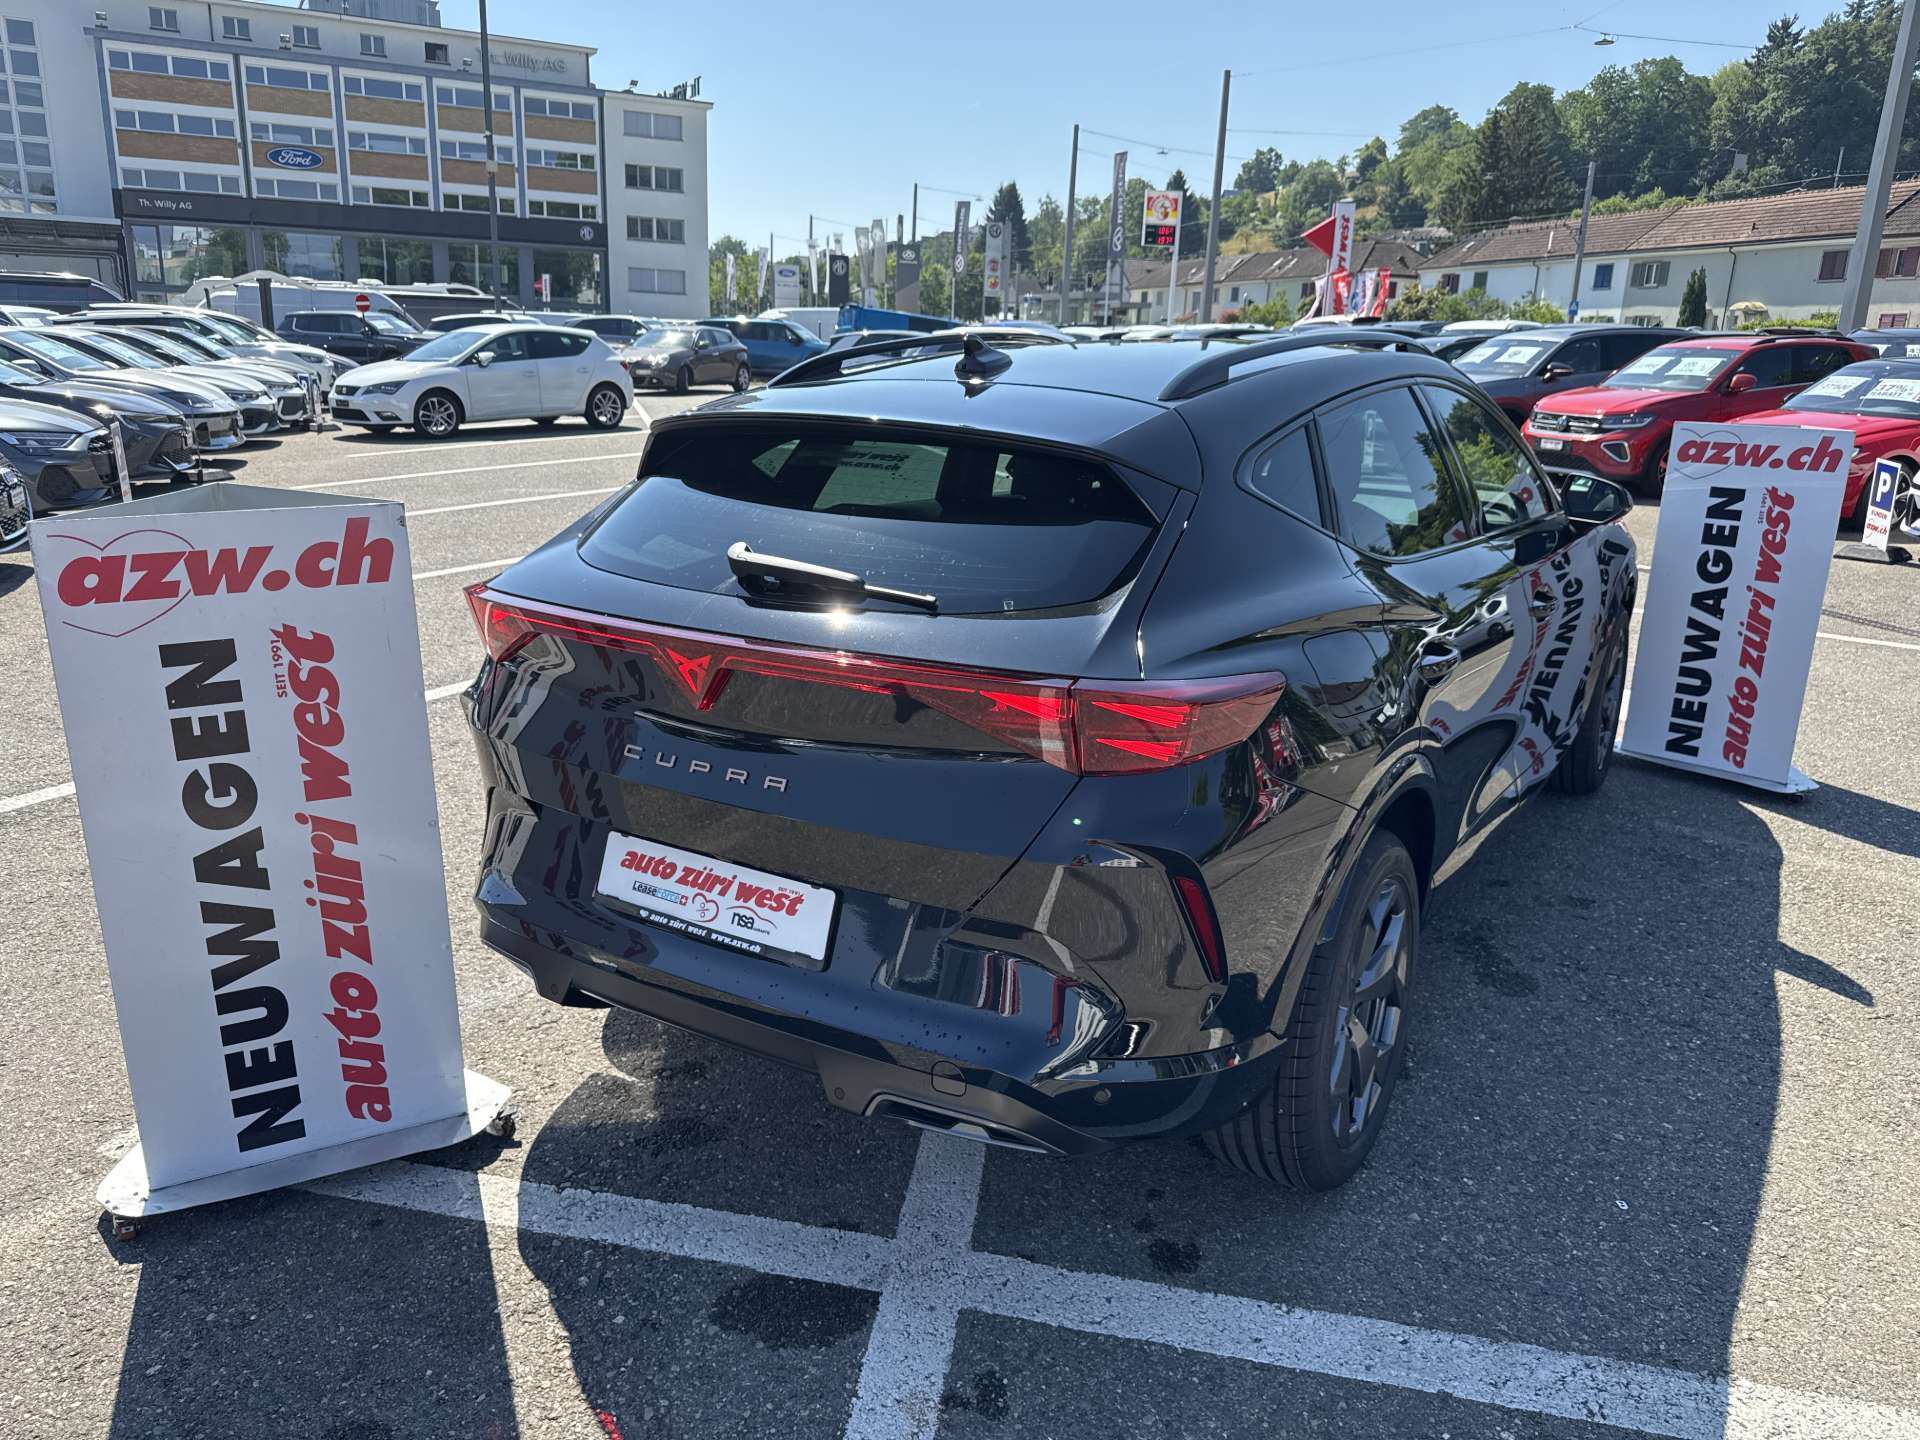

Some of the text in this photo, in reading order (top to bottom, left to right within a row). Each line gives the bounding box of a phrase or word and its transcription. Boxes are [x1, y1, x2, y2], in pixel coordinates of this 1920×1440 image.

[504, 50, 540, 73] Willy
[543, 55, 568, 74] AG
[278, 149, 312, 165] Ford
[138, 198, 193, 211] Th. Willy AG
[1676, 436, 1843, 473] azw.ch
[1876, 471, 1891, 502] P
[1866, 522, 1888, 535] azw.ch
[57, 516, 394, 608] azw.ch
[1665, 486, 1746, 757] NEUWAGEN
[1722, 486, 1795, 769] auto züri west
[270, 638, 289, 698] SEIT 1991
[623, 743, 790, 793] CUPRA
[270, 623, 392, 1122] auto züri west
[620, 849, 805, 917] auto züri west
[159, 638, 306, 1152] NEUWAGEN
[649, 914, 668, 924] auto
[668, 919, 687, 931] züri
[687, 925, 708, 937] west
[731, 911, 755, 930] nsa
